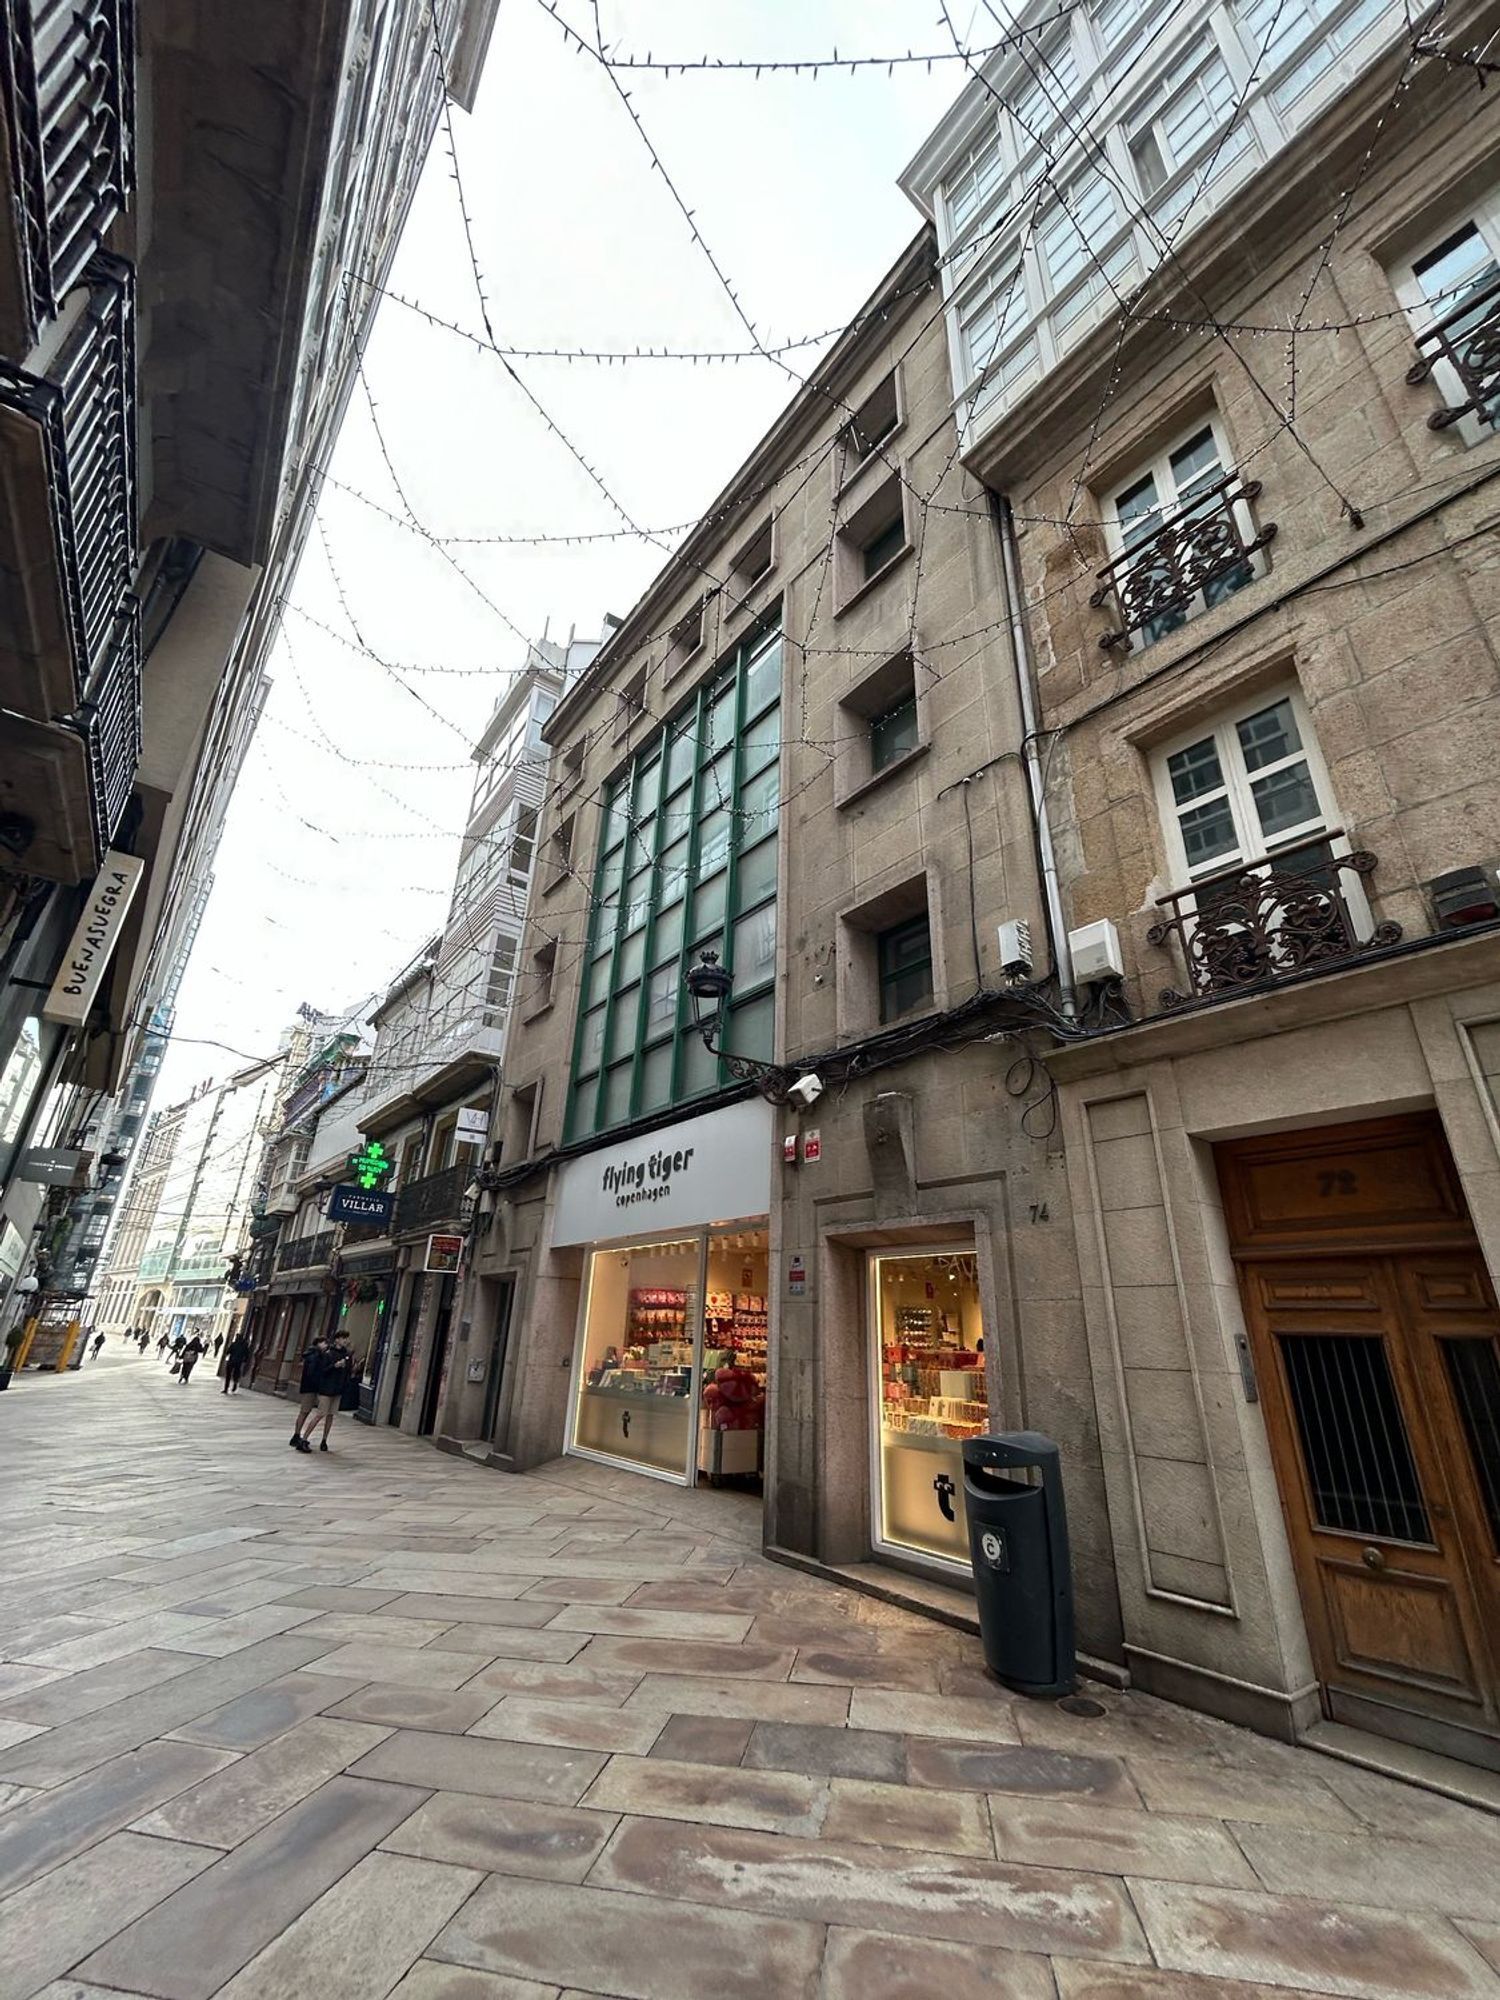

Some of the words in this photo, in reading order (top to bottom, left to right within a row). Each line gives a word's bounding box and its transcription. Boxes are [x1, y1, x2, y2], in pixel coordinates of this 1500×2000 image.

[63, 872, 128, 995] BUENASUEGRA
[603, 1161, 645, 1194] flying
[648, 1149, 694, 1182] tiger
[1316, 1169, 1359, 1197] 72
[342, 1198, 384, 1213] VILLAR
[615, 1185, 671, 1208] copenhagen
[1030, 1202, 1049, 1225] 74
